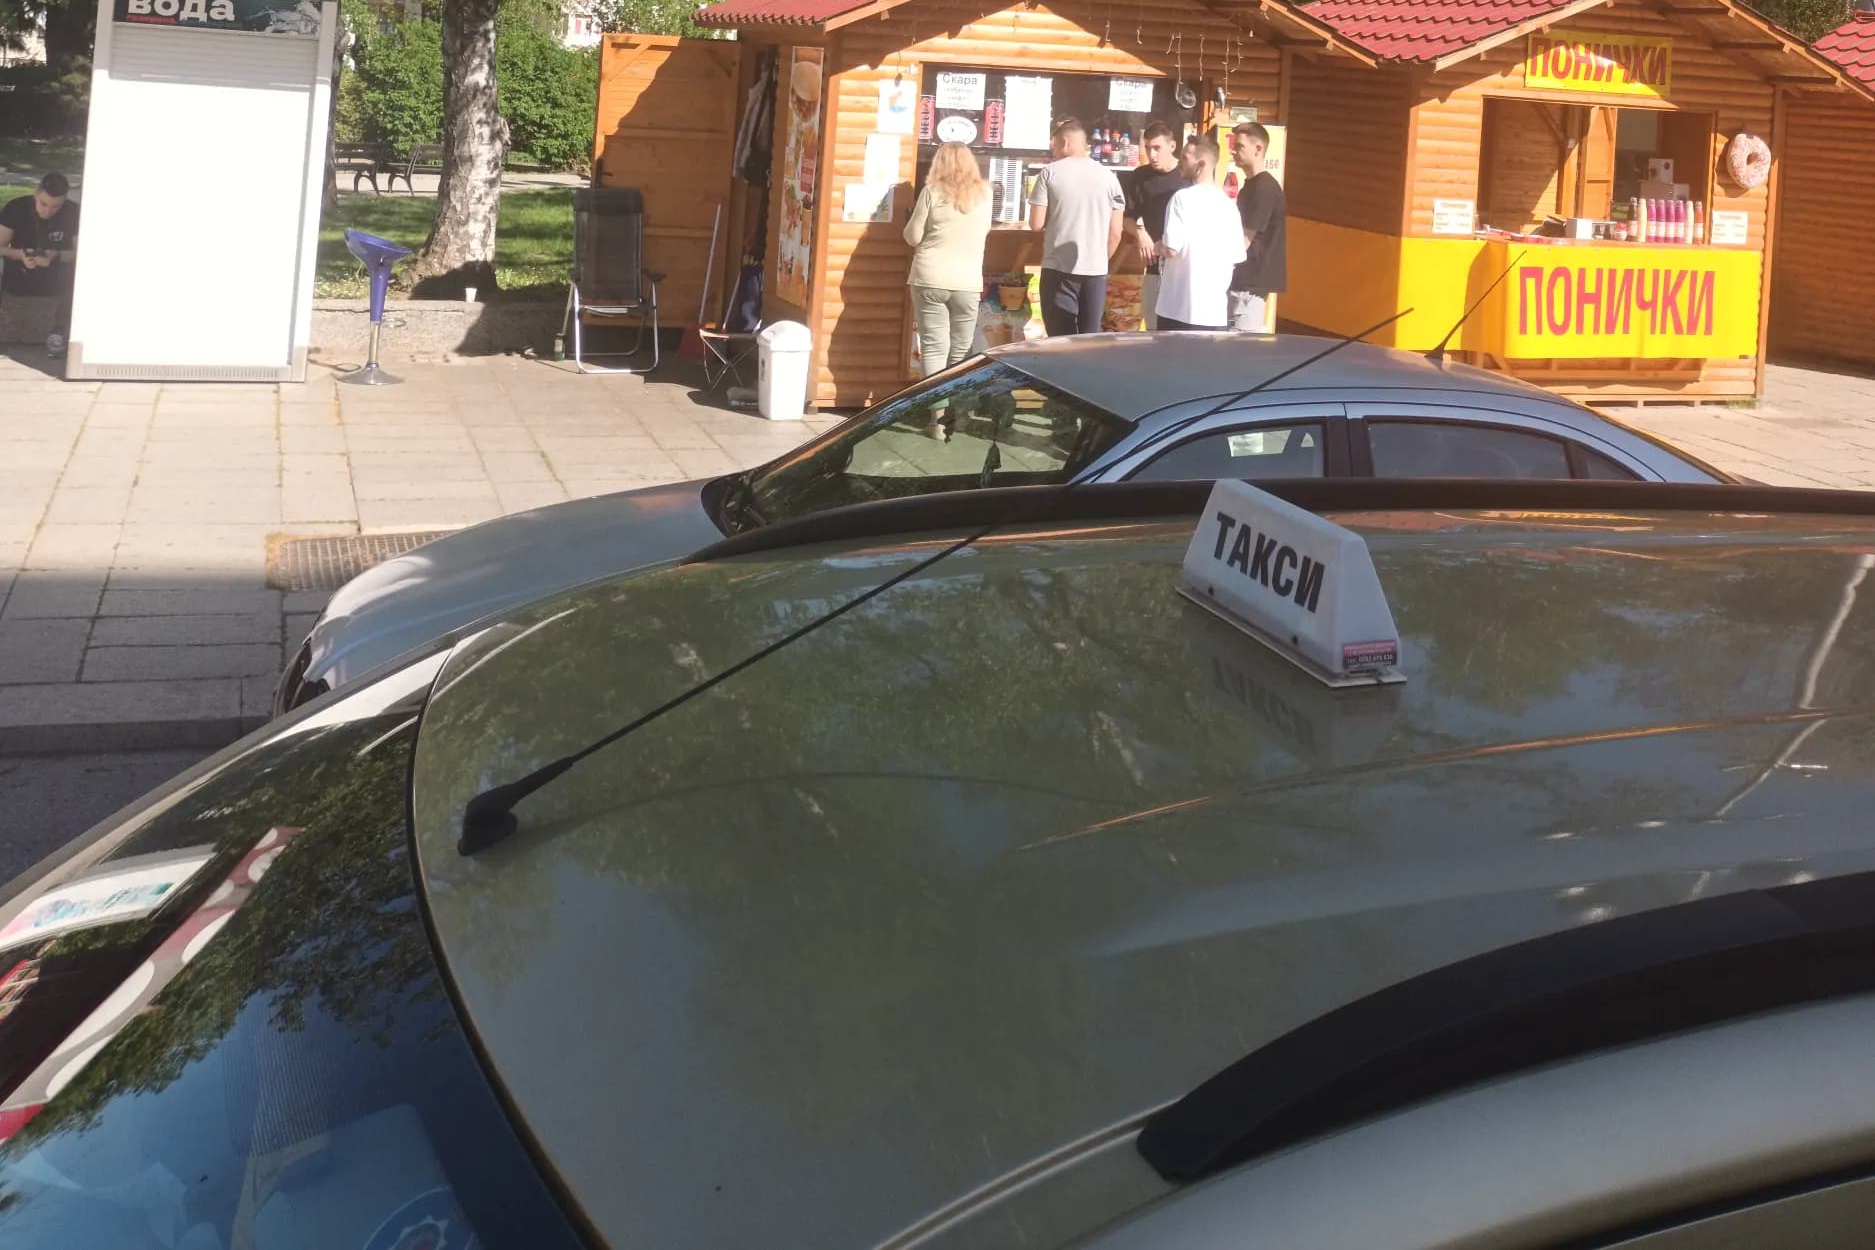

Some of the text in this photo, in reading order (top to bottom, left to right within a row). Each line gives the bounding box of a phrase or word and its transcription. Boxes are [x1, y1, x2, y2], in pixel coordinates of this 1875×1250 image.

[942, 72, 978, 86] Скара
[1529, 37, 1667, 85] ПОНИЧКИ
[1519, 266, 1715, 336] ПОНИЧКИ
[1213, 511, 1325, 613] ТАКСИ
